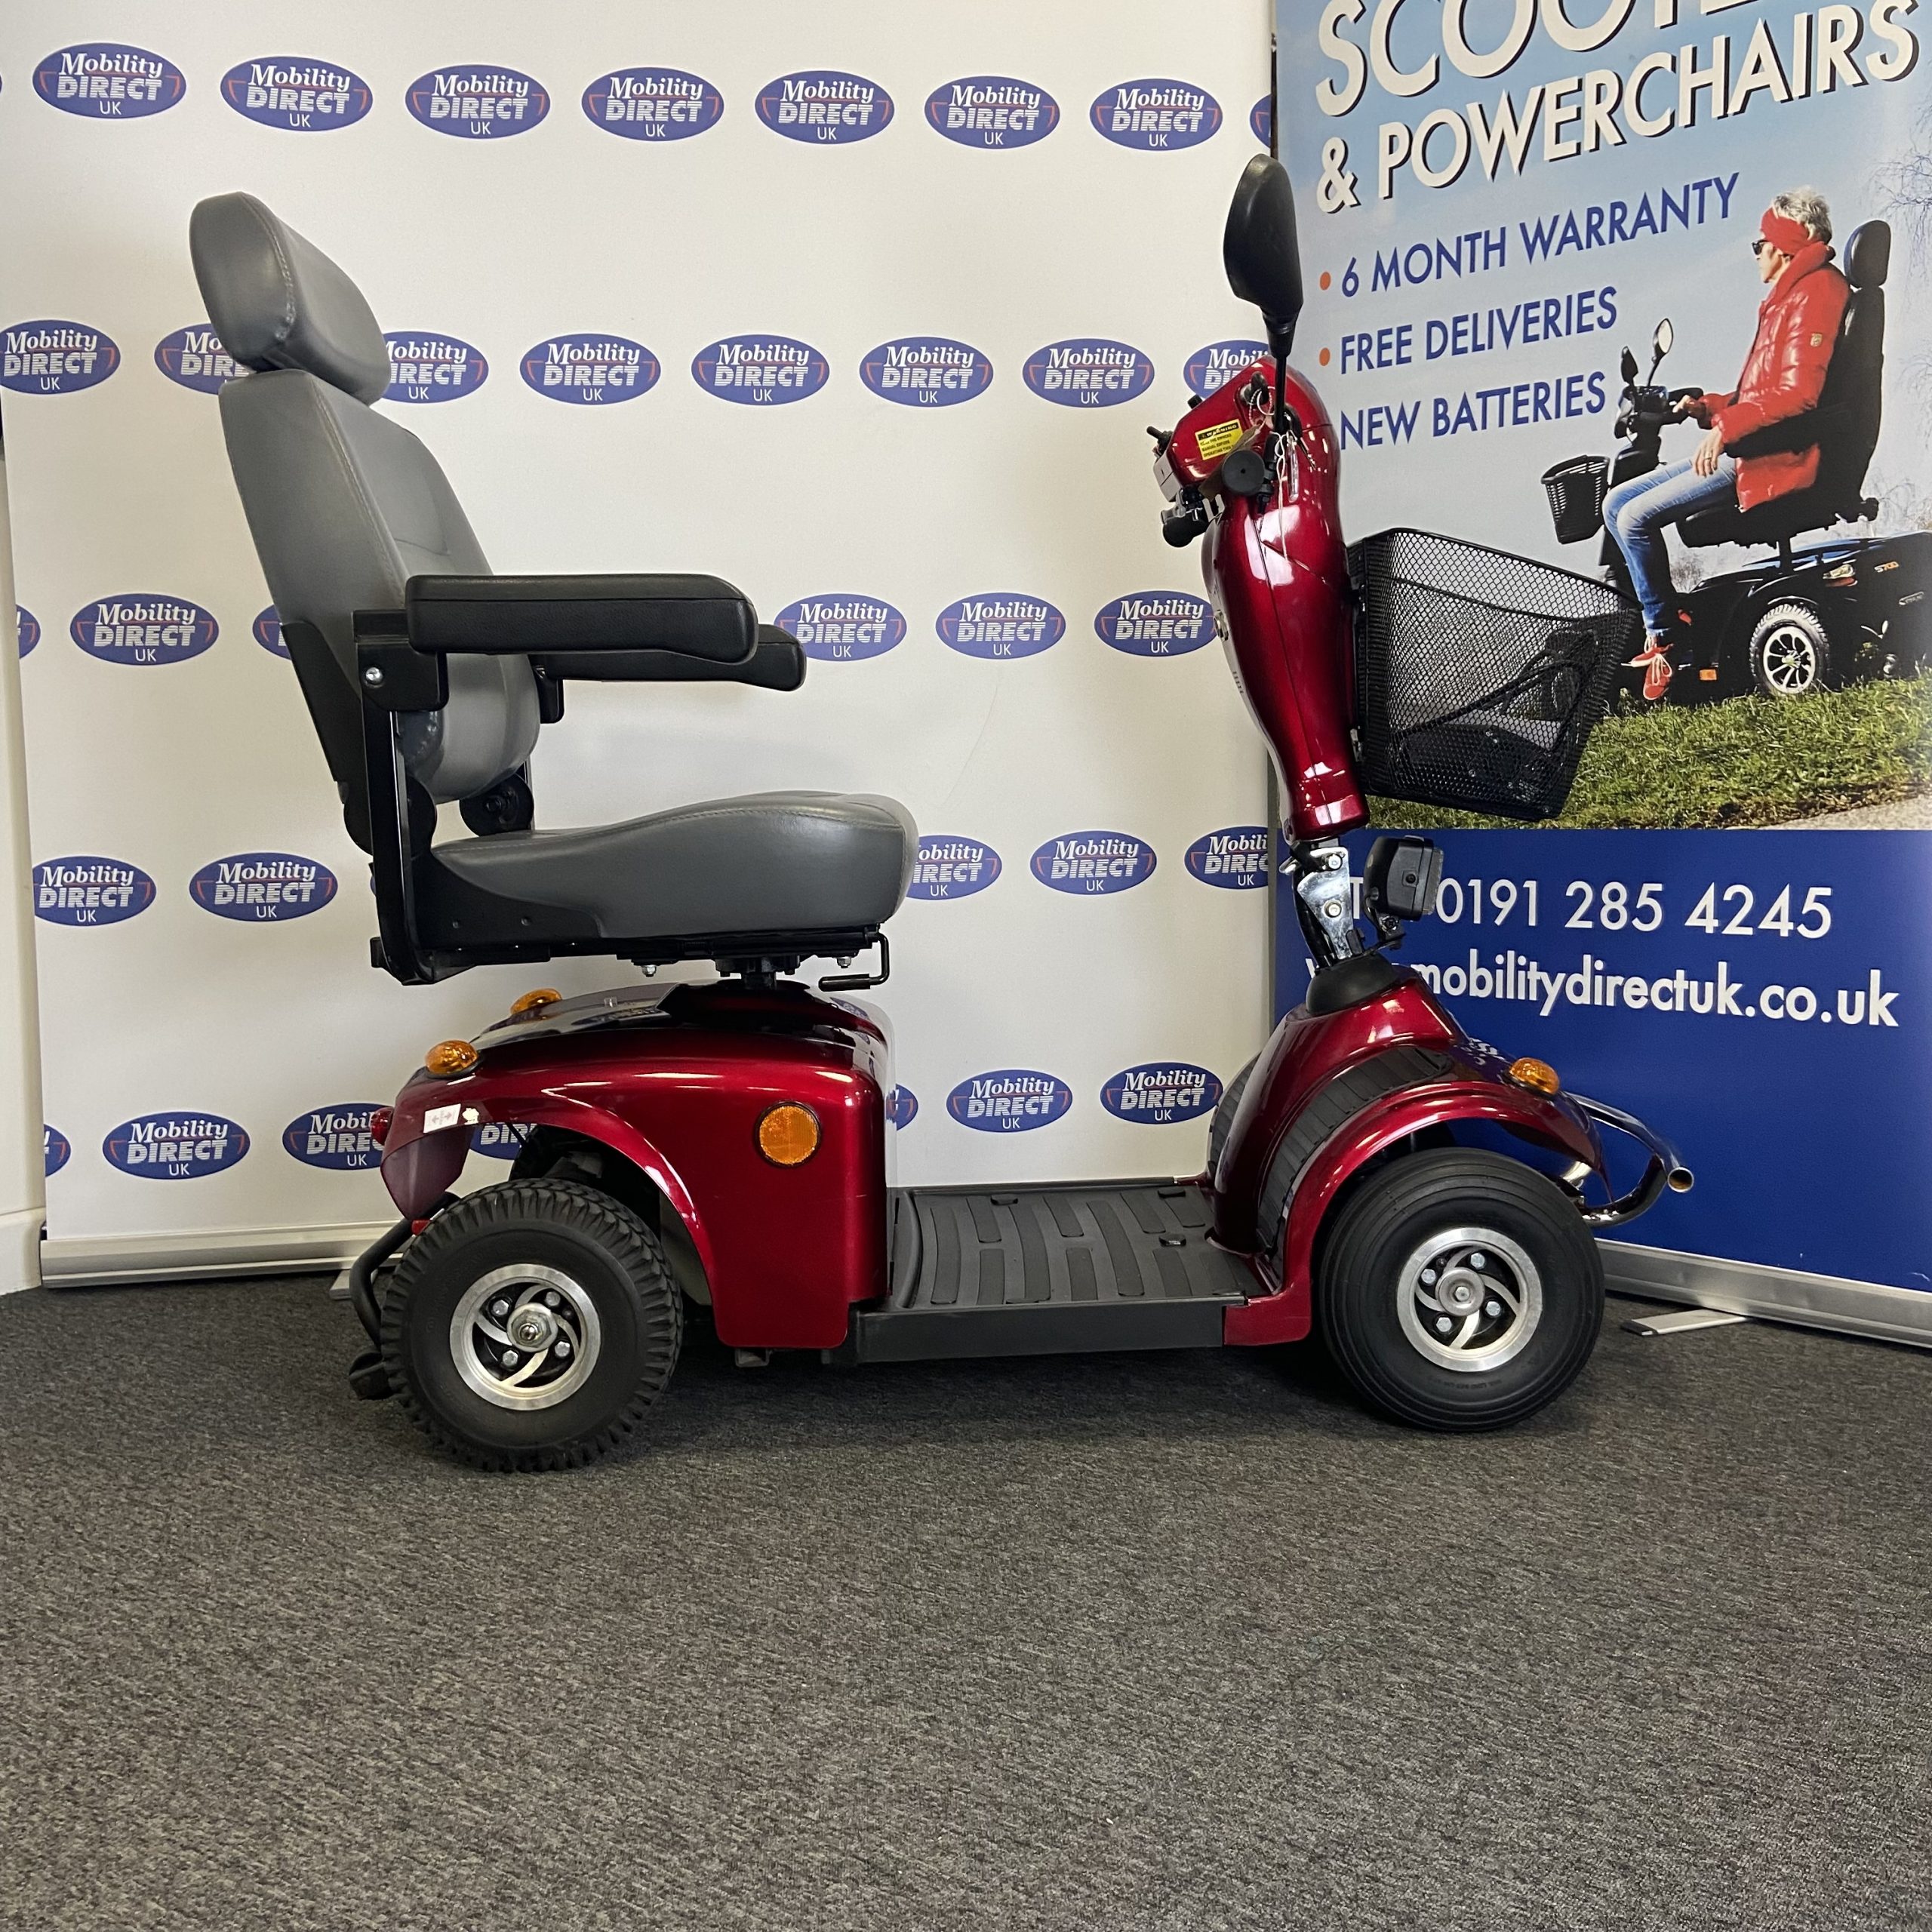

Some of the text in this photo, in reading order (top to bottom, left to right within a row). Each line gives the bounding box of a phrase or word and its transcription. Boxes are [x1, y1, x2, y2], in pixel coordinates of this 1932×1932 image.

[58, 53, 163, 78] Mobility
[57, 75, 162, 101] DIRECT
[248, 63, 351, 93] Mobility
[431, 74, 529, 98] Mobility
[607, 76, 703, 100] Mobility
[246, 86, 350, 114] DIRECT
[780, 79, 875, 104] Mobility
[948, 85, 1041, 109] Mobility
[1113, 88, 1204, 111] Mobility
[99, 100, 122, 115] UK
[429, 97, 528, 120] DIRECT
[605, 99, 703, 122] DIRECT
[778, 102, 874, 125] DIRECT
[1316, 0, 1919, 214] & POWERCHAIRS
[289, 112, 311, 128] UK
[470, 121, 491, 135] UK
[946, 106, 1040, 131] DIRECT
[1112, 109, 1204, 133] DIRECT
[645, 124, 666, 137] UK
[817, 126, 837, 140] UK
[984, 131, 1004, 145] UK
[1149, 134, 1168, 147] UK
[1341, 171, 1740, 298] 6 MONTH WARRANTY
[1340, 285, 1617, 374] FREE DELIVERIES
[4, 329, 98, 355] Mobility
[3, 352, 97, 377] DIRECT
[545, 343, 641, 365] Mobility
[715, 344, 810, 366] Mobility
[883, 346, 974, 369] Mobility
[1045, 347, 1136, 369] Mobility
[40, 377, 60, 391] UK
[389, 363, 466, 385] IRECT
[543, 365, 640, 386] DIRECT
[714, 365, 809, 387] DIRECT
[881, 367, 974, 389] DIRECT
[1044, 368, 1135, 389] DIRECT
[408, 386, 429, 400] UK
[583, 388, 603, 401] UK
[753, 389, 773, 401] UK
[919, 390, 938, 404] UK
[1081, 391, 1100, 405] UK
[1340, 371, 1606, 451] NEW BATTERIES
[94, 603, 196, 626] Mobility
[797, 602, 888, 623] Mobility
[958, 601, 1048, 623] Mobility
[1117, 599, 1204, 620] Mobility
[94, 625, 195, 647] DIRECT
[795, 623, 887, 644] DIRECT
[956, 621, 1046, 642] DIRECT
[1115, 619, 1203, 640] DIRECT
[135, 648, 157, 662] UK
[832, 645, 852, 658] UK
[993, 643, 1012, 656] UK
[1151, 641, 1169, 654] UK
[918, 843, 983, 863] obility
[1054, 838, 1139, 859] Mobility
[1206, 834, 1268, 855] Mobili
[215, 861, 316, 884] Mobility
[912, 863, 983, 884] IRECT
[1051, 857, 1138, 879] DIRECT
[1204, 853, 1268, 874] DIREC
[39, 865, 134, 888] Mobility
[1085, 879, 1104, 892] UK
[1238, 874, 1254, 886] UK
[38, 884, 134, 909] DIRECT
[214, 880, 315, 905] DIRECT
[930, 884, 949, 897] UK
[76, 909, 97, 923] UK
[256, 905, 277, 918] UK
[1435, 878, 1537, 927] 0191
[1564, 881, 1664, 932] 285
[1684, 882, 1832, 940] 4245
[969, 1077, 1055, 1100] Mobility
[1122, 1070, 1206, 1091] Mobility
[967, 1095, 1054, 1118] DIRECT
[1120, 1088, 1205, 1110] DIRECT
[1002, 1117, 1021, 1131] UK
[1154, 1107, 1173, 1122] UK
[128, 1119, 228, 1144] Mobility
[127, 1139, 228, 1164] DIRECT
[347, 1154, 367, 1166] UK
[168, 1163, 190, 1177] UK
